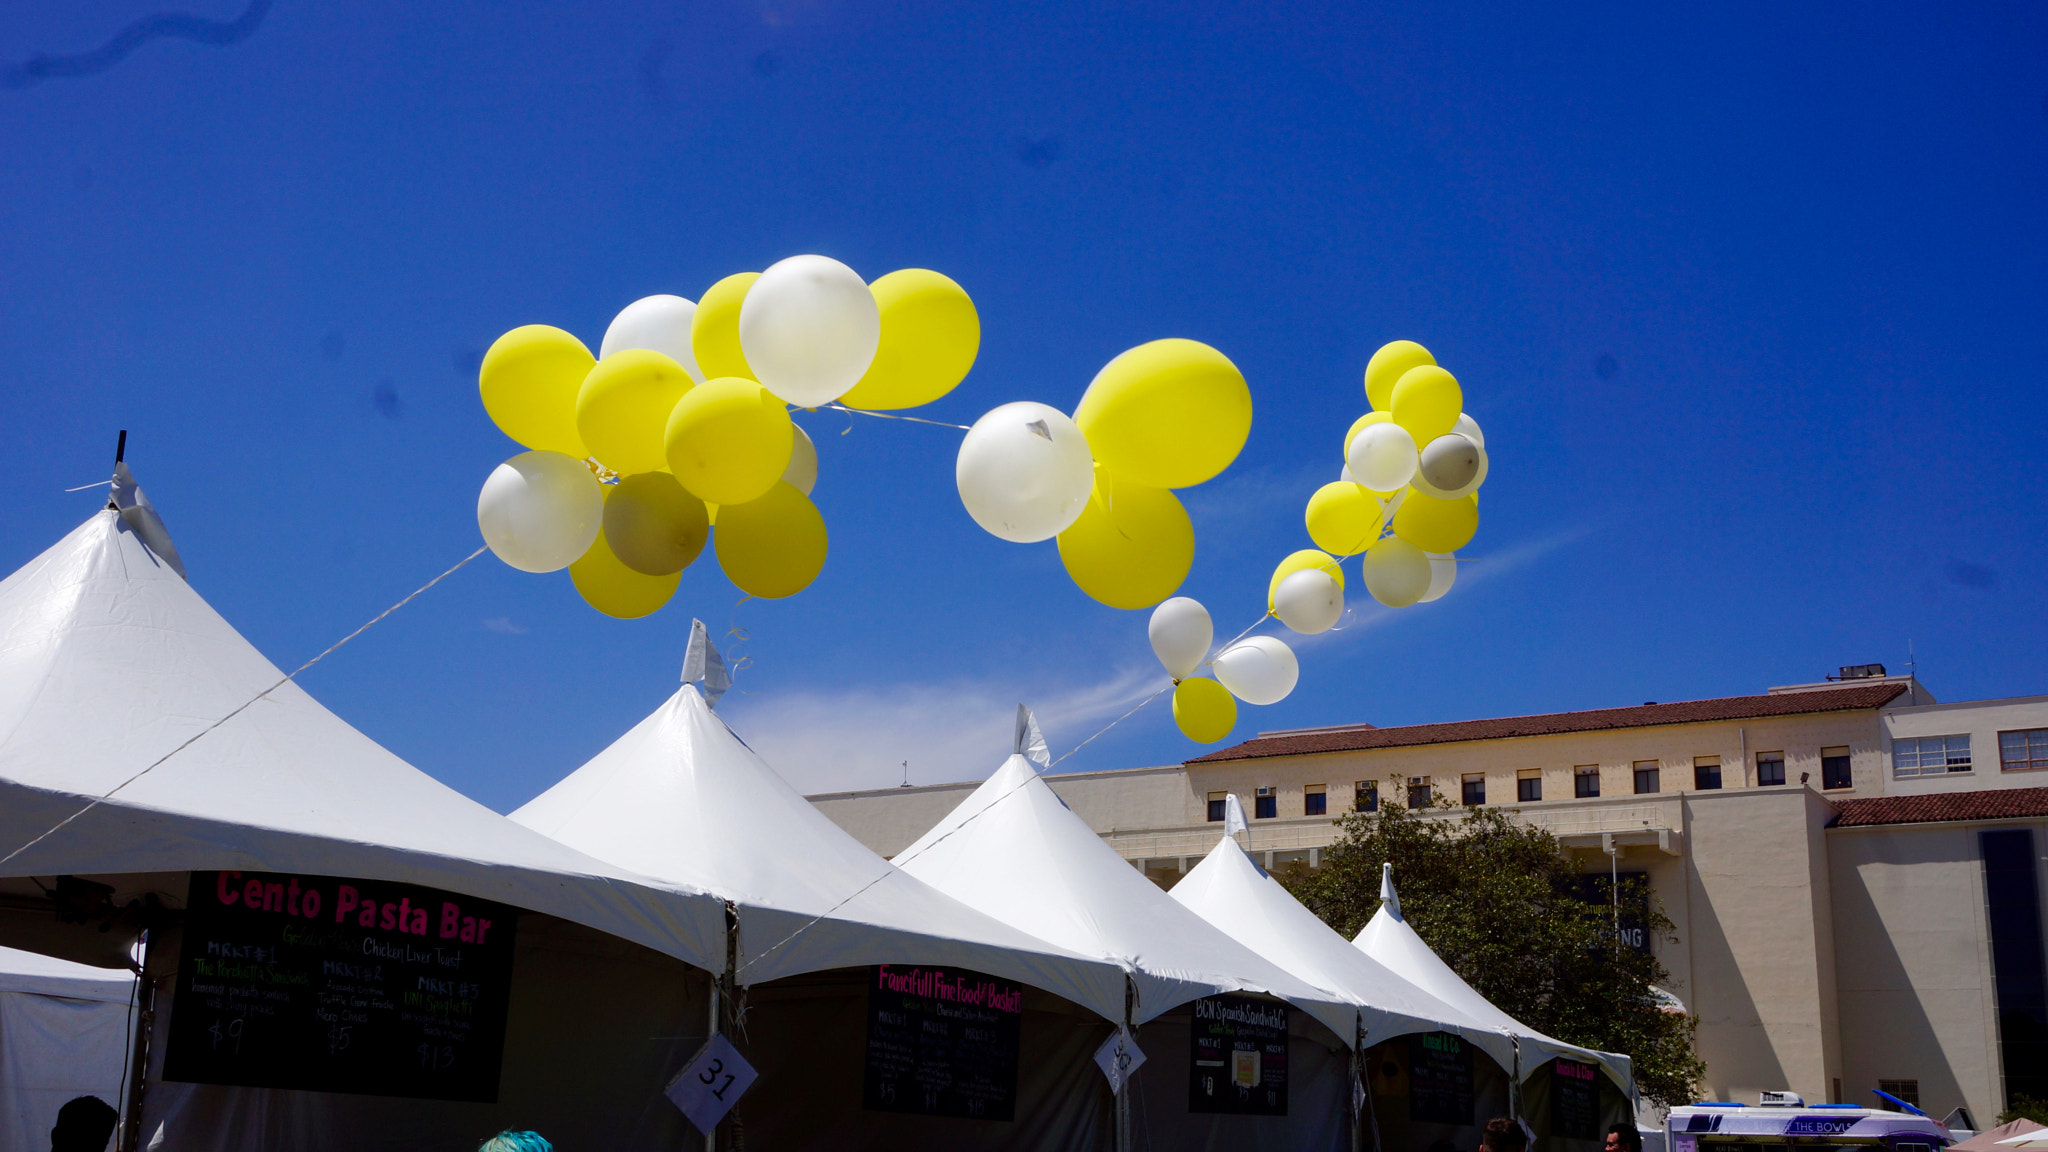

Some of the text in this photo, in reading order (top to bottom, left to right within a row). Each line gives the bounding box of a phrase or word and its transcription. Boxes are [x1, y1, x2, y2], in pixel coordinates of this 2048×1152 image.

[216, 871, 492, 944] Cento Pasta Bar
[207, 940, 251, 959] MRKT
[361, 937, 462, 970] Chicken Liver Toast
[193, 958, 215, 976] The
[322, 960, 363, 980] MRKT
[417, 976, 456, 998] MRKT
[879, 964, 933, 999] Fancifull
[934, 971, 956, 1002] Fine
[988, 982, 1021, 1014] Baskets
[1196, 999, 1214, 1020] BCN
[1216, 1001, 1246, 1026] Spanish
[1246, 1004, 1278, 1028] Sandwich
[699, 1058, 736, 1101] 31
[1795, 1121, 1814, 1132] THE
[1816, 1122, 1852, 1132] BOWLS
